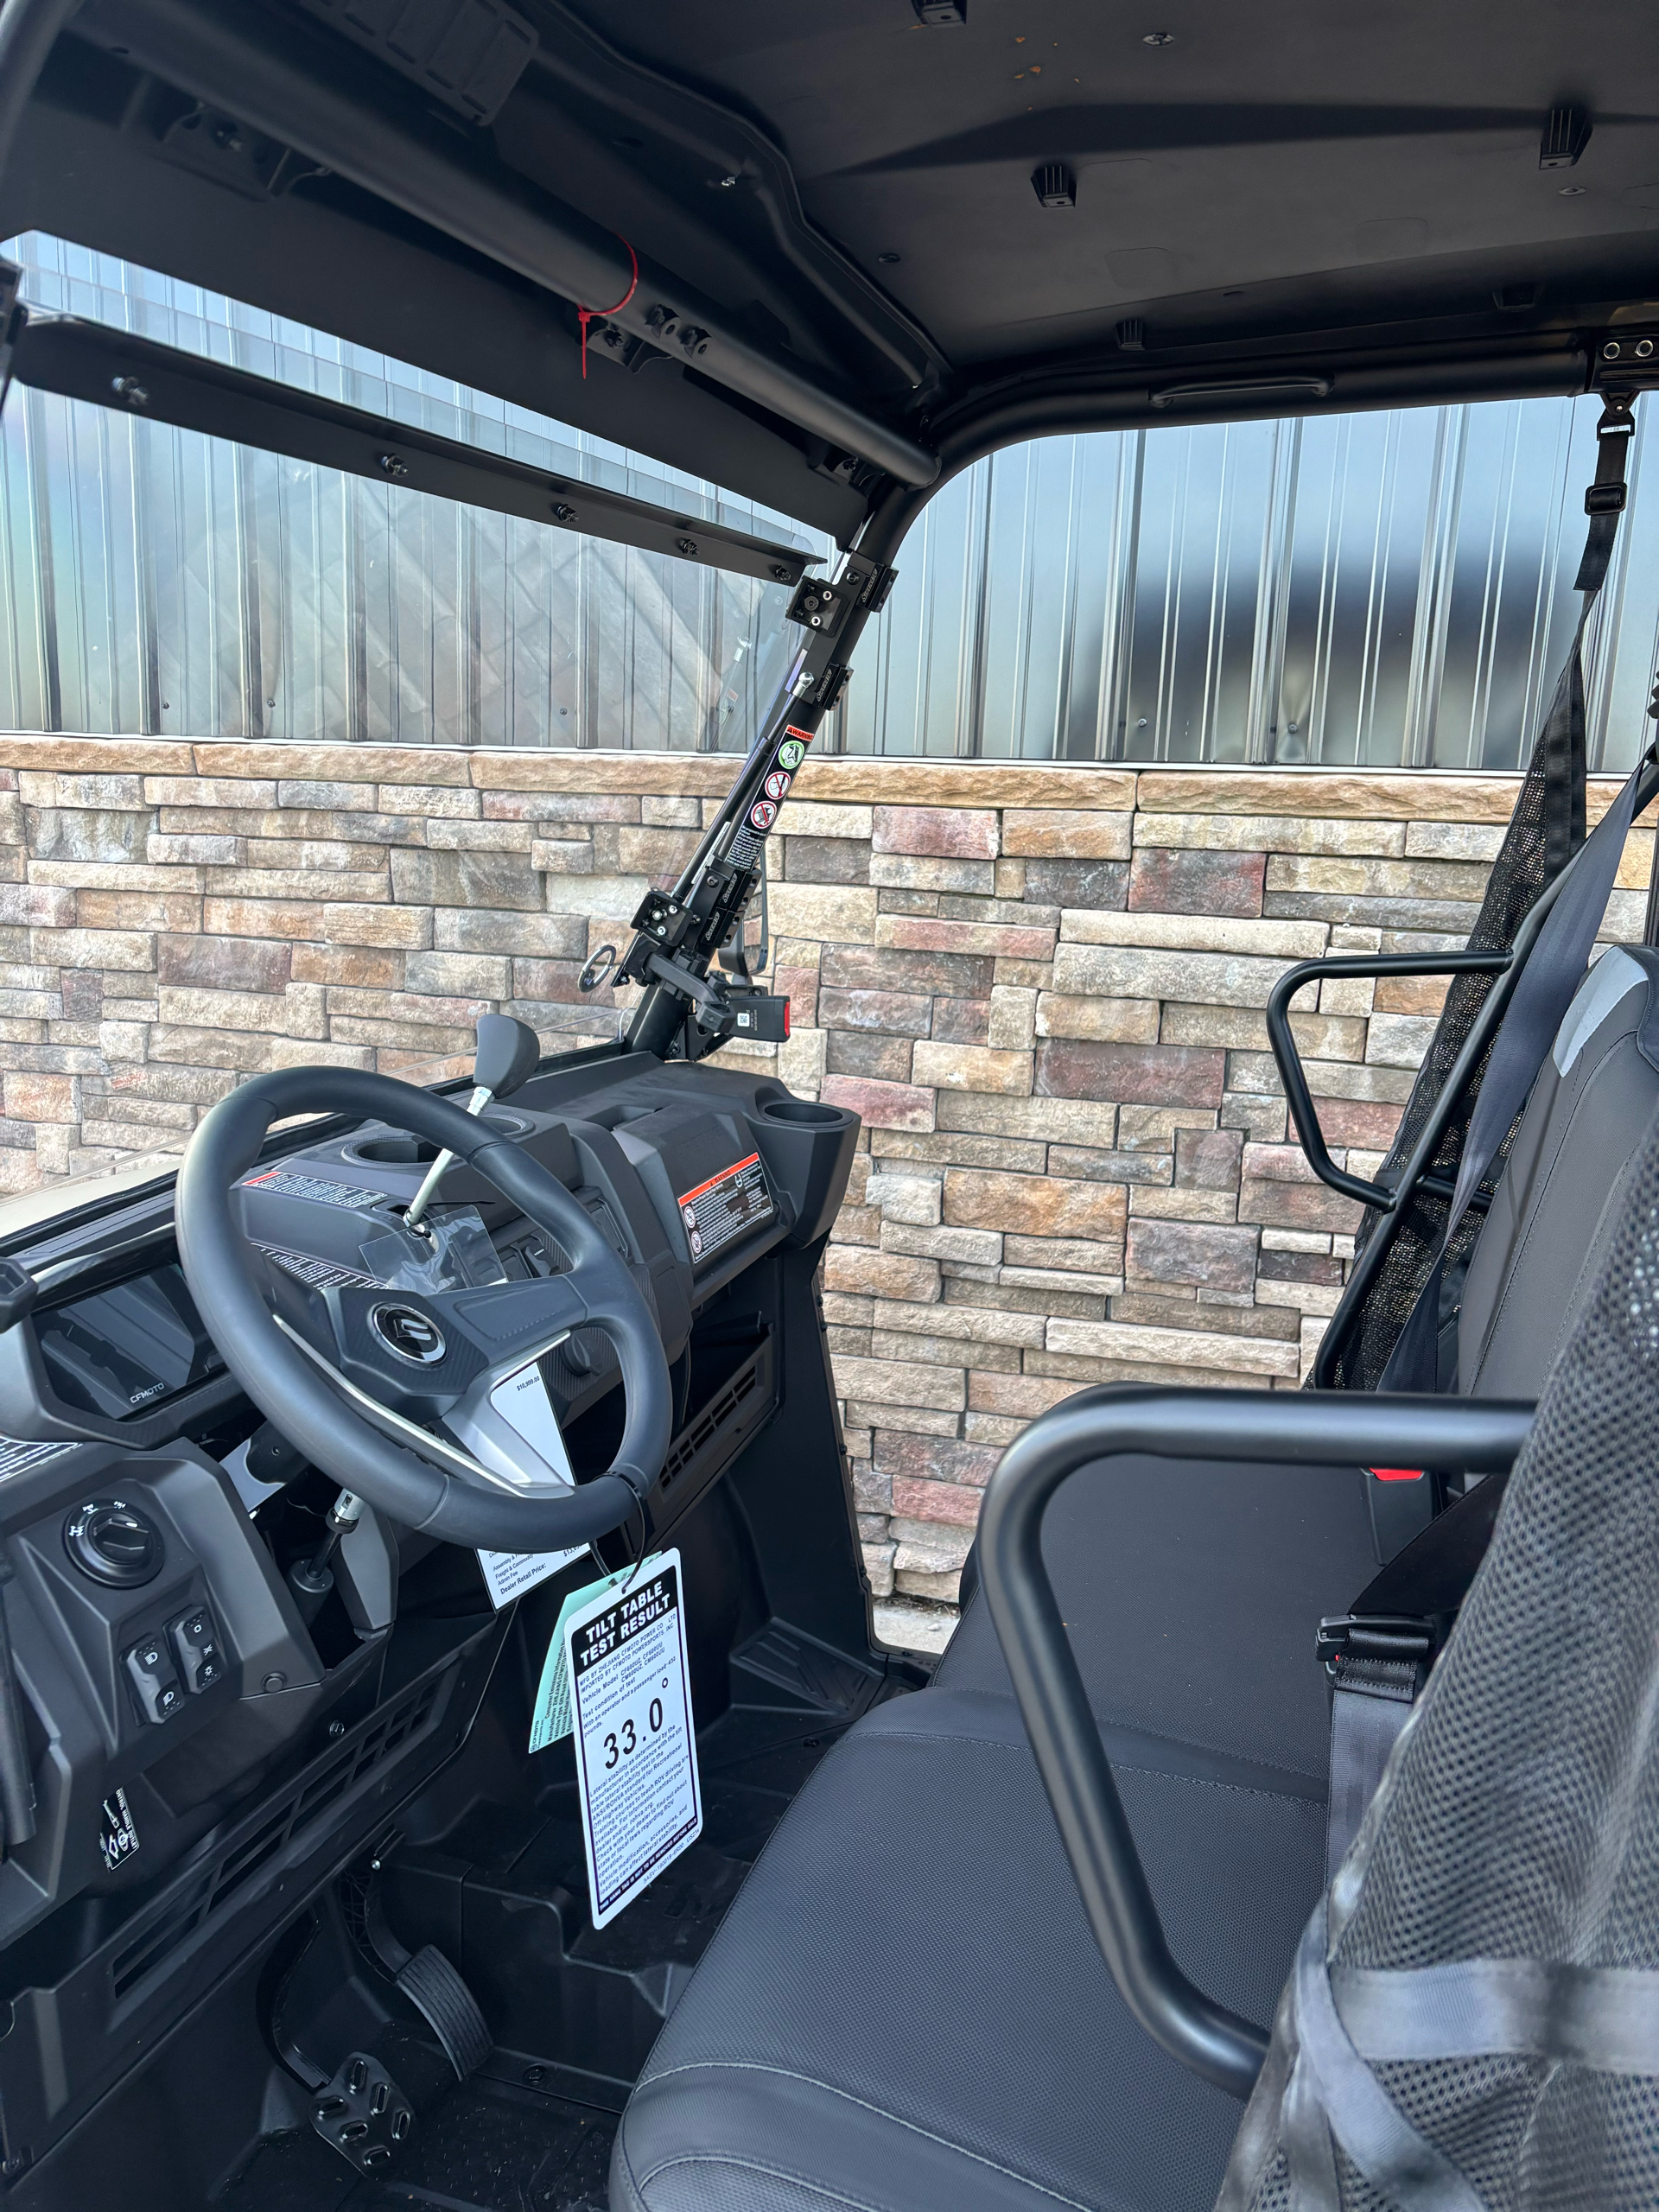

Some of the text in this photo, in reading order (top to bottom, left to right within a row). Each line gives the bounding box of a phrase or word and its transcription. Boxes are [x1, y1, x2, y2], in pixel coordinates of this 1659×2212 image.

[130, 1382, 164, 1404] CFMOTO
[517, 1376, 540, 1392] $10,999.00
[493, 1558, 511, 1571] Assembly
[495, 1568, 509, 1579] Freight
[499, 1576, 510, 1586] Admin
[500, 1563, 547, 1595] Dealer Retail Price:
[580, 1593, 670, 1667] TEST RESULT
[586, 1581, 662, 1643] TILT TABLE
[580, 1676, 589, 1686] MFG
[598, 1654, 619, 1673] ZHEJIANG
[621, 1639, 639, 1656] CFMOTO
[640, 1628, 655, 1642] POWER
[580, 1673, 603, 1694] IMPORTED
[612, 1653, 630, 1670] CFMOTO
[582, 1687, 601, 1704] Vehicle
[583, 1708, 593, 1720] Test
[595, 1689, 617, 1711] condition
[584, 1718, 594, 1730] With
[601, 1698, 620, 1718] operator
[621, 1691, 629, 1701] and
[634, 1672, 656, 1693] passenger
[584, 1718, 603, 1738] pounds.
[590, 1779, 607, 1797] Lateral
[608, 1762, 627, 1783] stability
[635, 1734, 661, 1761] determined
[662, 1730, 667, 1739] by
[591, 1774, 623, 1806] manufacturer
[630, 1747, 656, 1773] accordance
[657, 1738, 667, 1750] with
[591, 1800, 603, 1814] table
[605, 1786, 620, 1803] lateral
[621, 1769, 640, 1790] stability
[641, 1761, 650, 1772] test
[592, 1791, 623, 1822] ANSI/ROHVA
[624, 1773, 645, 1795] standard
[653, 1742, 681, 1770] Recreational
[593, 1781, 645, 1831] Off-Highway Vehicles.
[594, 1815, 614, 1838] Training
[615, 1800, 634, 1819] courses
[641, 1782, 653, 1797] teach
[654, 1773, 664, 1786] ROV
[665, 1759, 681, 1778] driving
[595, 1821, 618, 1846] available.
[628, 1789, 655, 1817] information
[656, 1775, 672, 1793] contact
[673, 1766, 683, 1779] your
[597, 1844, 612, 1862] Check
[613, 1834, 623, 1847] with
[624, 1825, 635, 1839] your
[636, 1811, 650, 1827] dealer
[656, 1798, 665, 1809] find
[674, 1779, 686, 1794] about
[596, 1837, 611, 1854] dealer
[612, 1822, 627, 1840] and/or
[597, 1856, 610, 1870] state
[617, 1839, 628, 1853] local
[629, 1829, 640, 1842] laws
[641, 1808, 663, 1833] regarding
[664, 1798, 674, 1810] ROV
[599, 1867, 617, 1888] Vehicle
[678, 1804, 686, 1815] and
[600, 1821, 677, 1897] loading can affect lateral stability.
[598, 1852, 623, 1879] operation.
